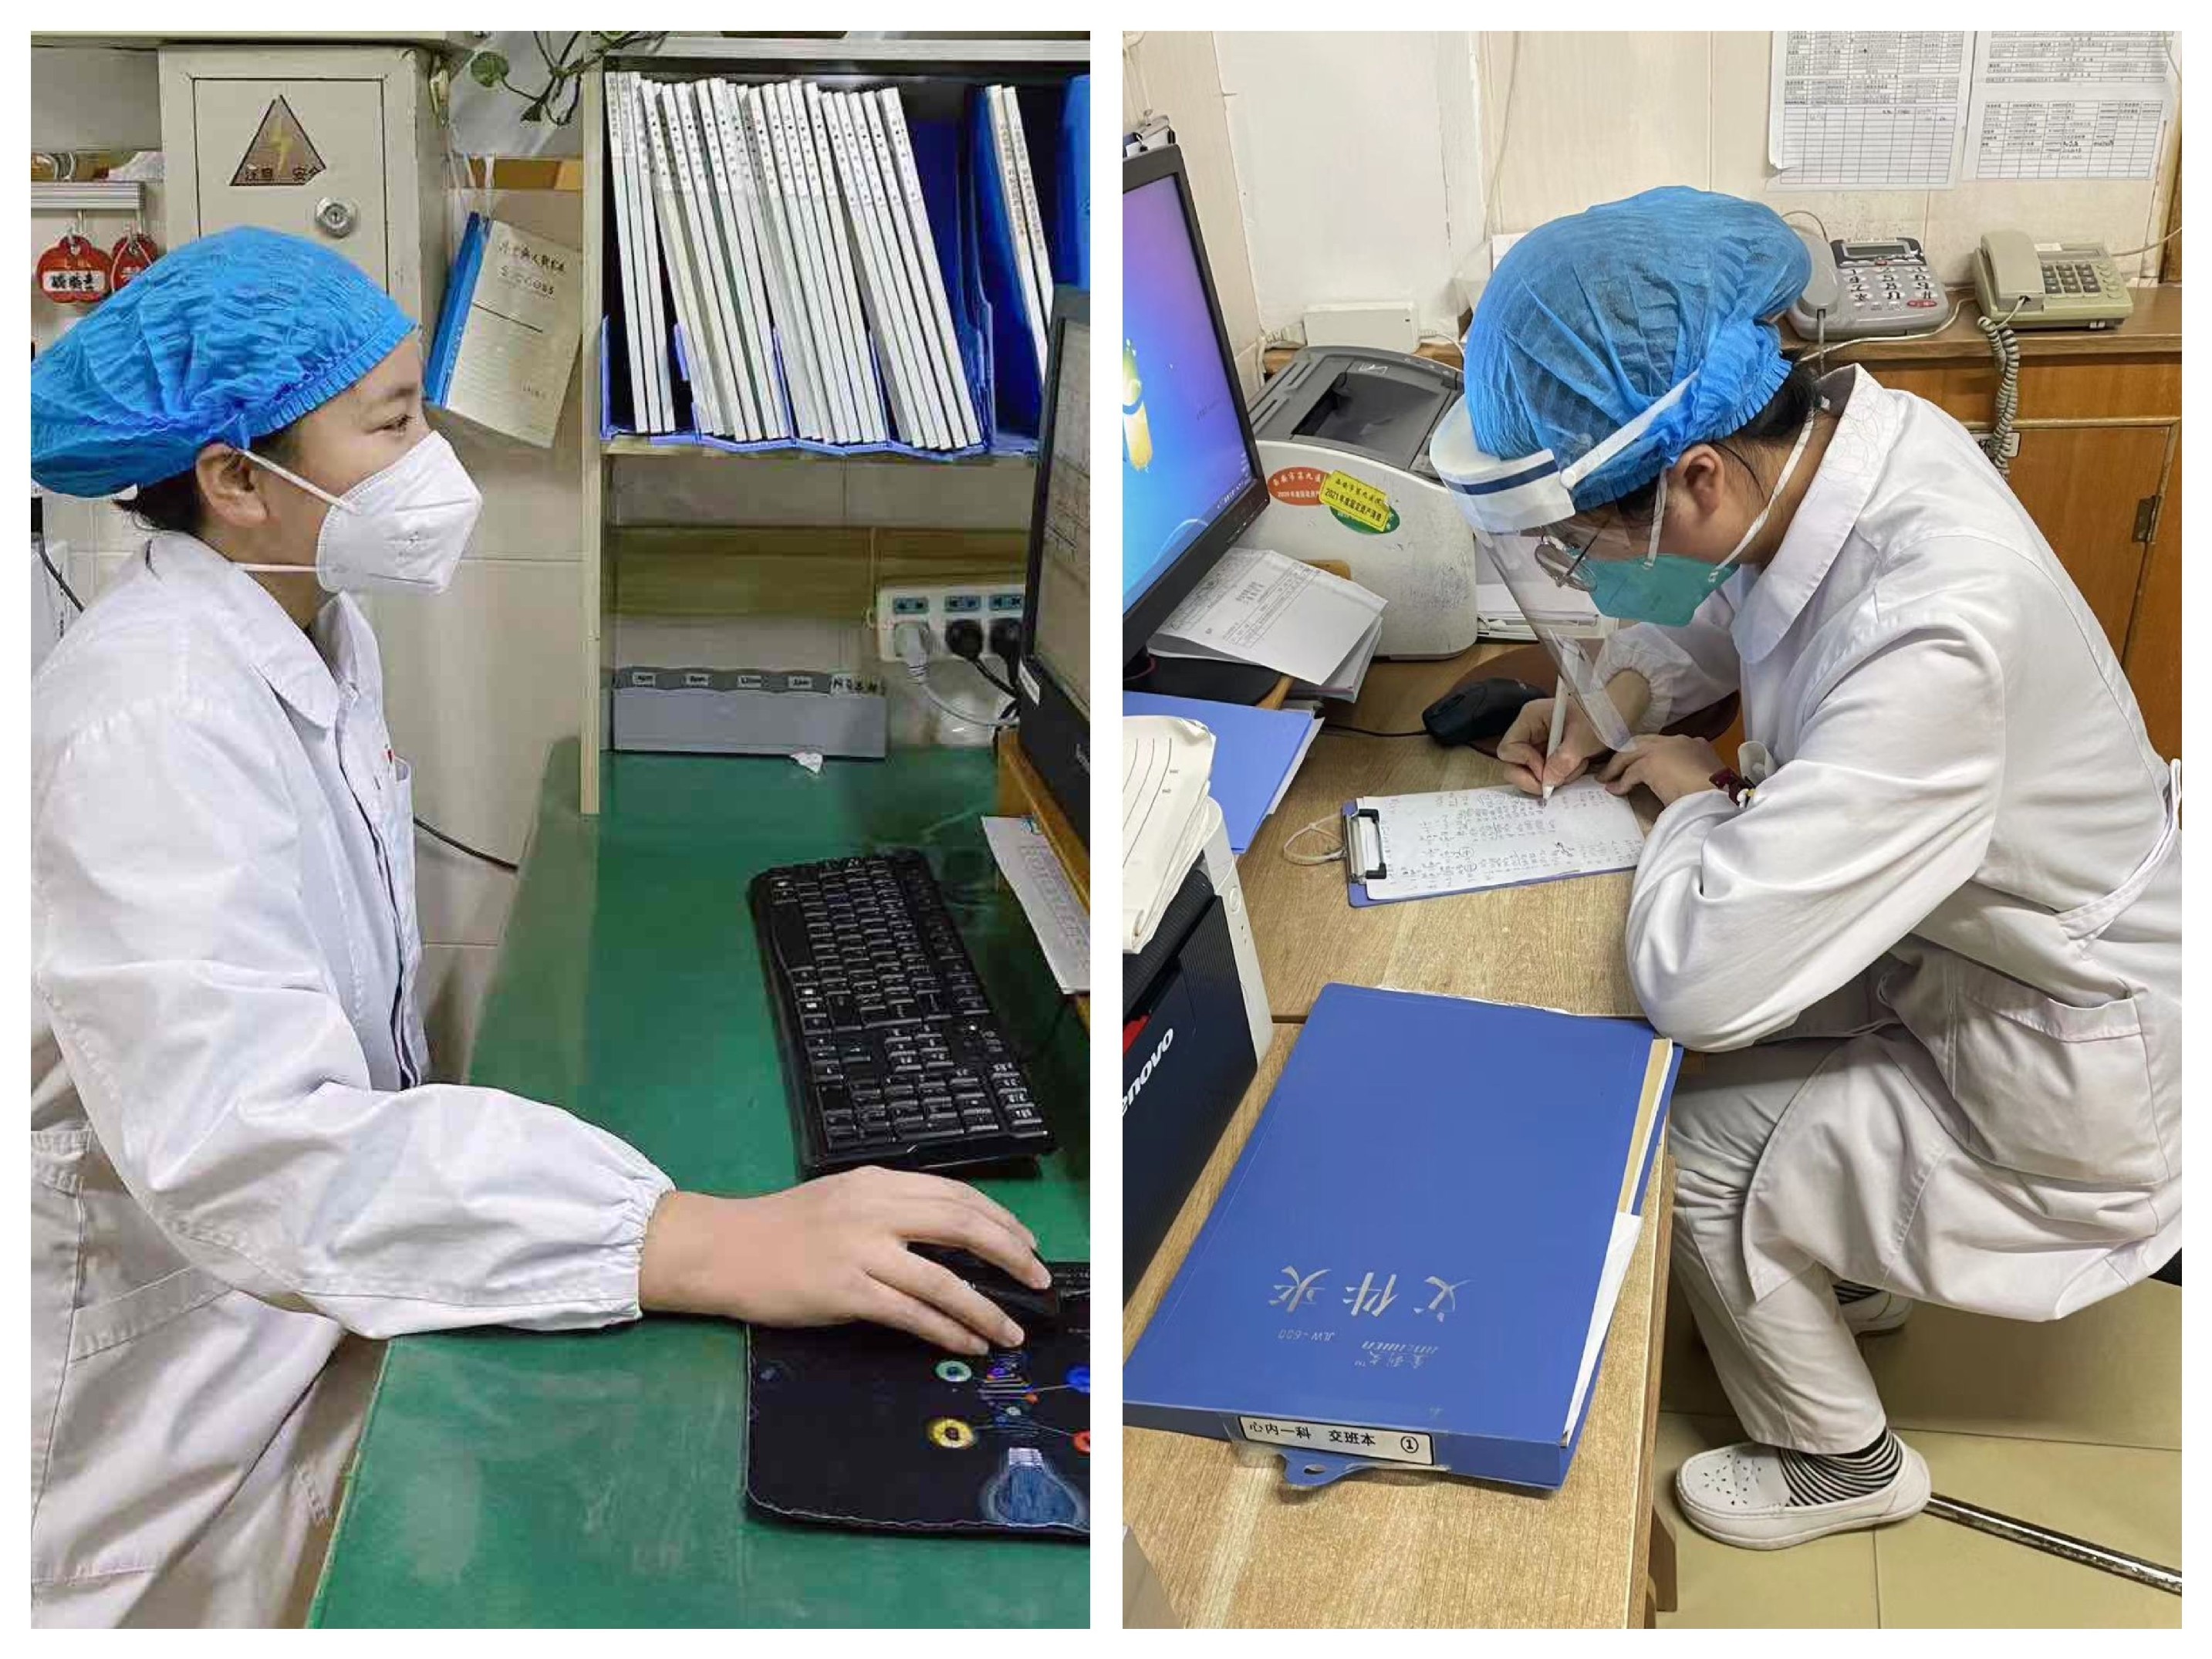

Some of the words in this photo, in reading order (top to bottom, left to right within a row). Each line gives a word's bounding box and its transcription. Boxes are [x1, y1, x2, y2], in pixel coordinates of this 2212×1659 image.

[1123, 1028, 1174, 1117] enovo
[1268, 1265, 1477, 1323] 文件夹
[1249, 1421, 1312, 1440] 心内一科
[1329, 1429, 1376, 1447] 交班本
